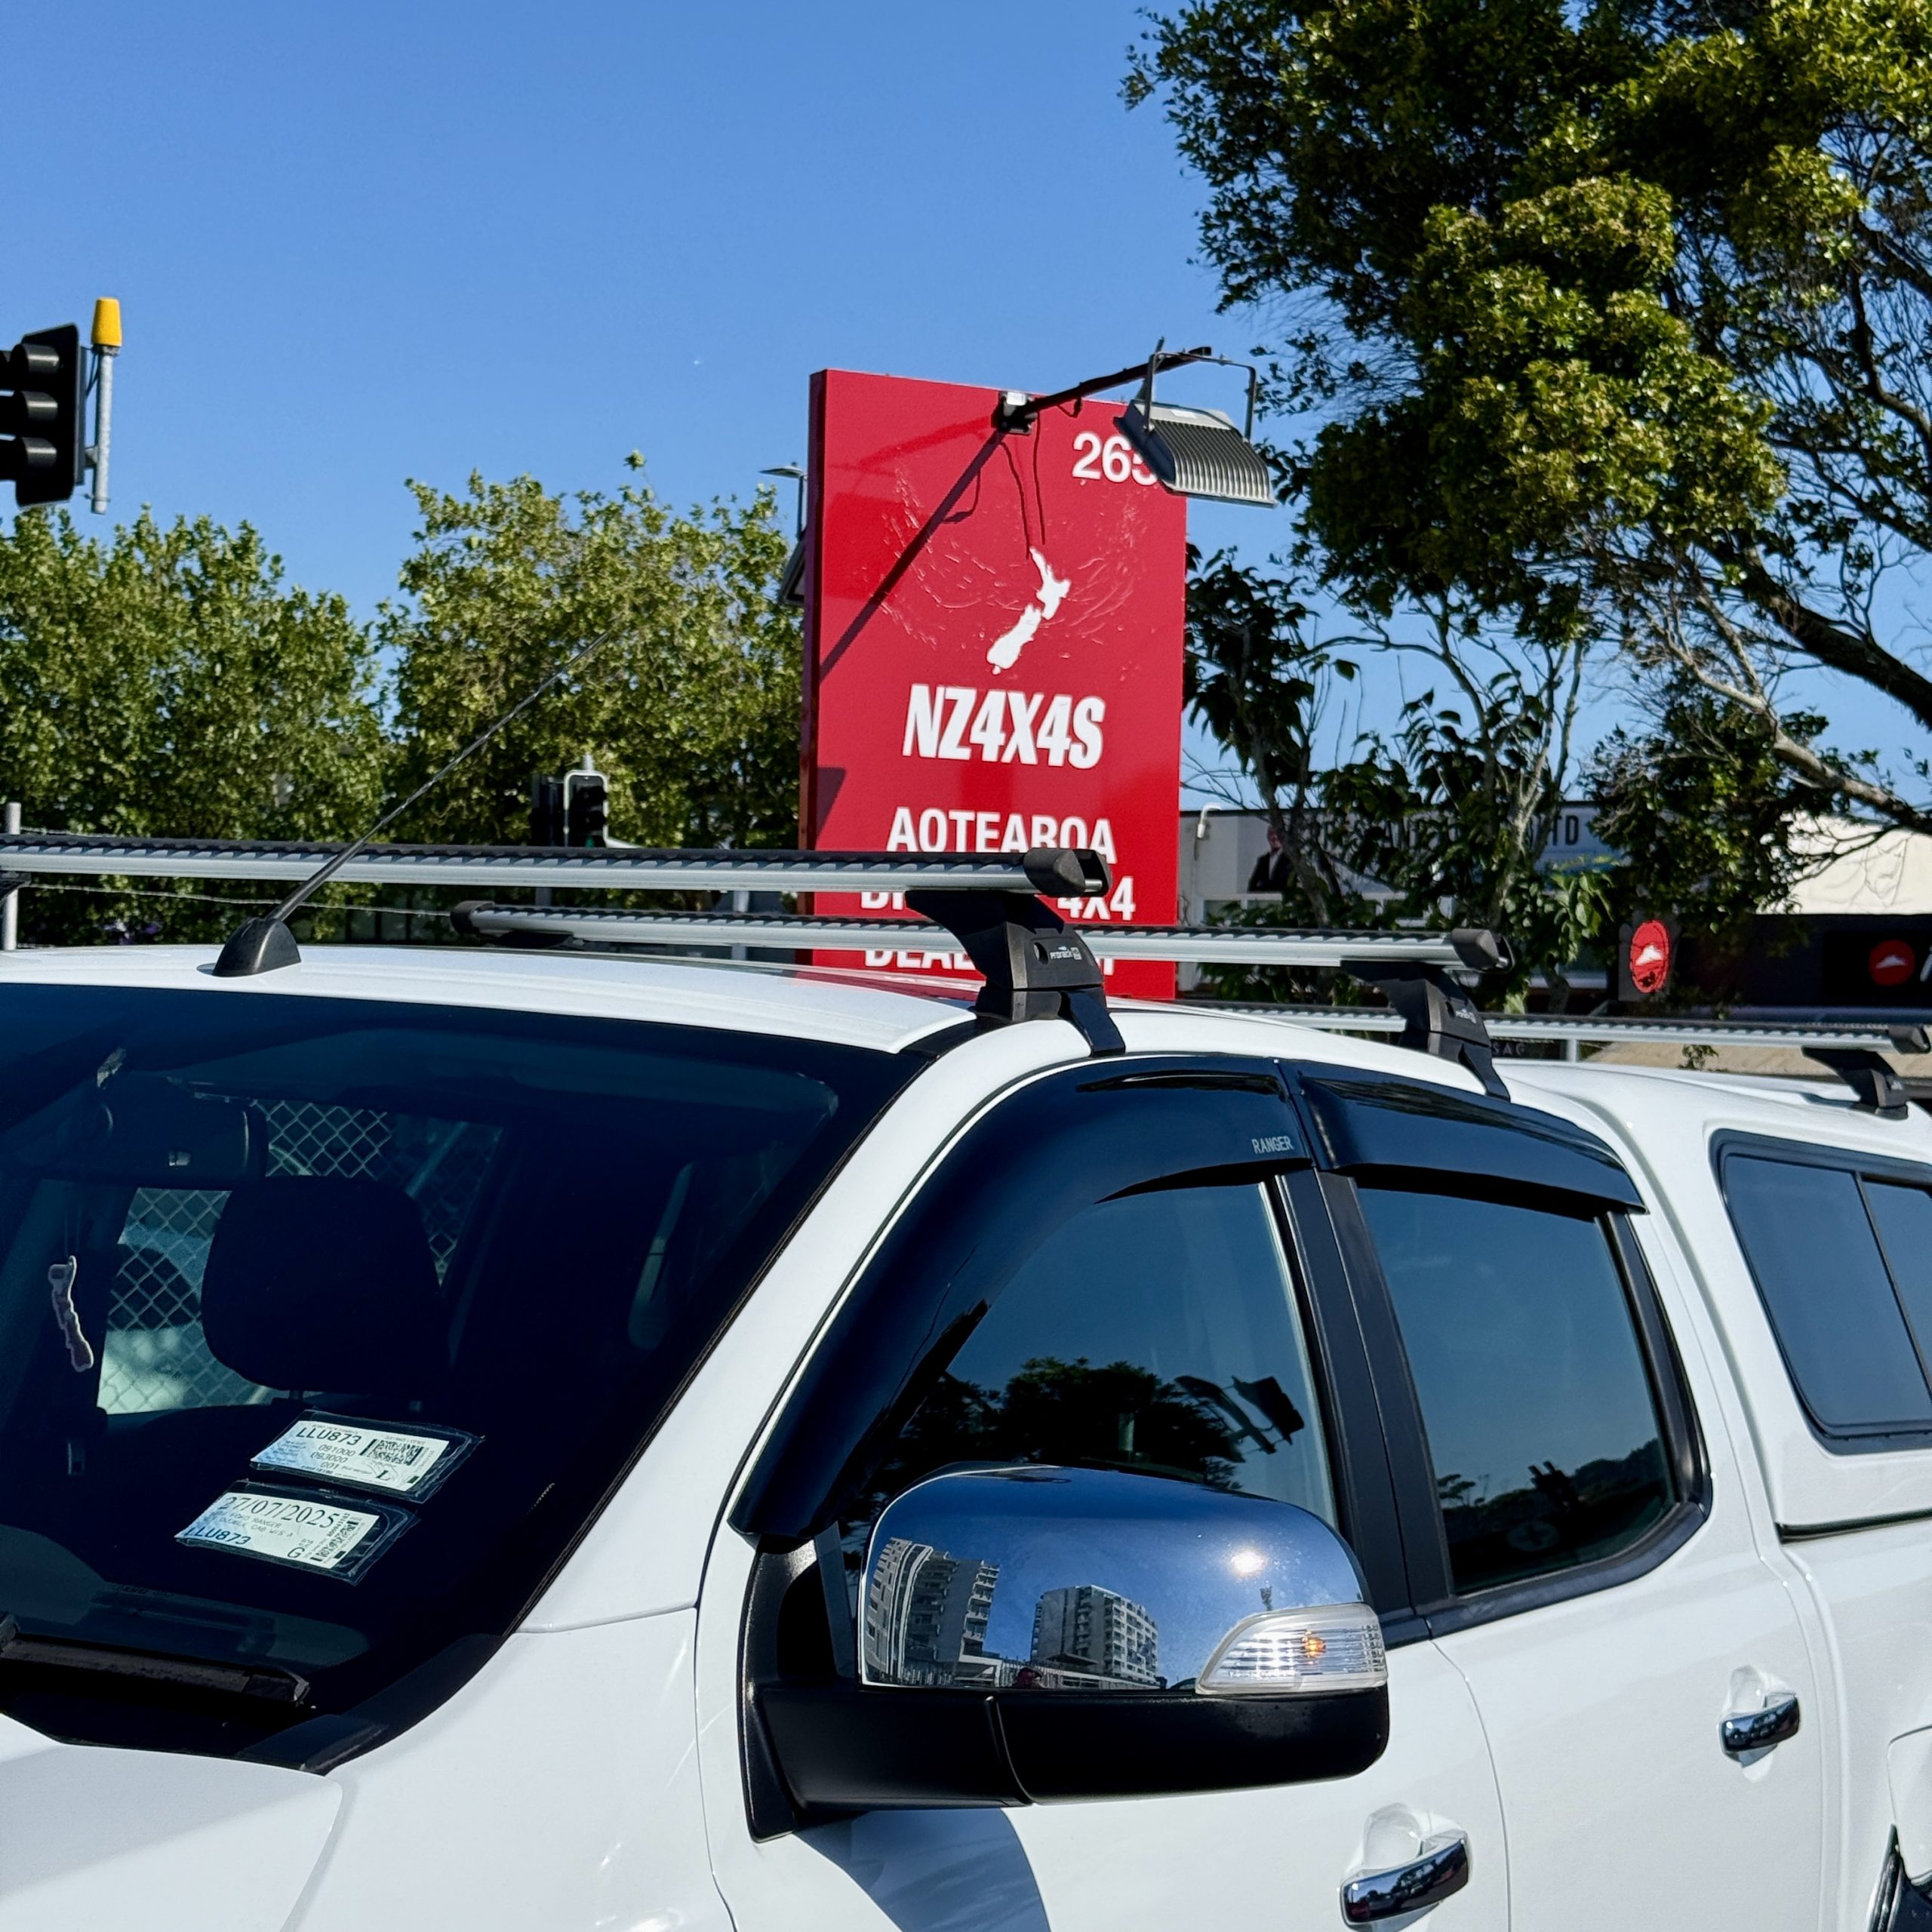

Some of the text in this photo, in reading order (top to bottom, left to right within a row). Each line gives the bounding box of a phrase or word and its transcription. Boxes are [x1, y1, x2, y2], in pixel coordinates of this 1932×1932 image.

[902, 683, 1106, 770] NZ4X4S
[1251, 1135, 1294, 1154] RANGER
[295, 1427, 361, 1446] LLU873
[217, 1496, 340, 1529] 27/07/2025
[183, 1525, 252, 1545] LLU873
[287, 1546, 306, 1558] G
